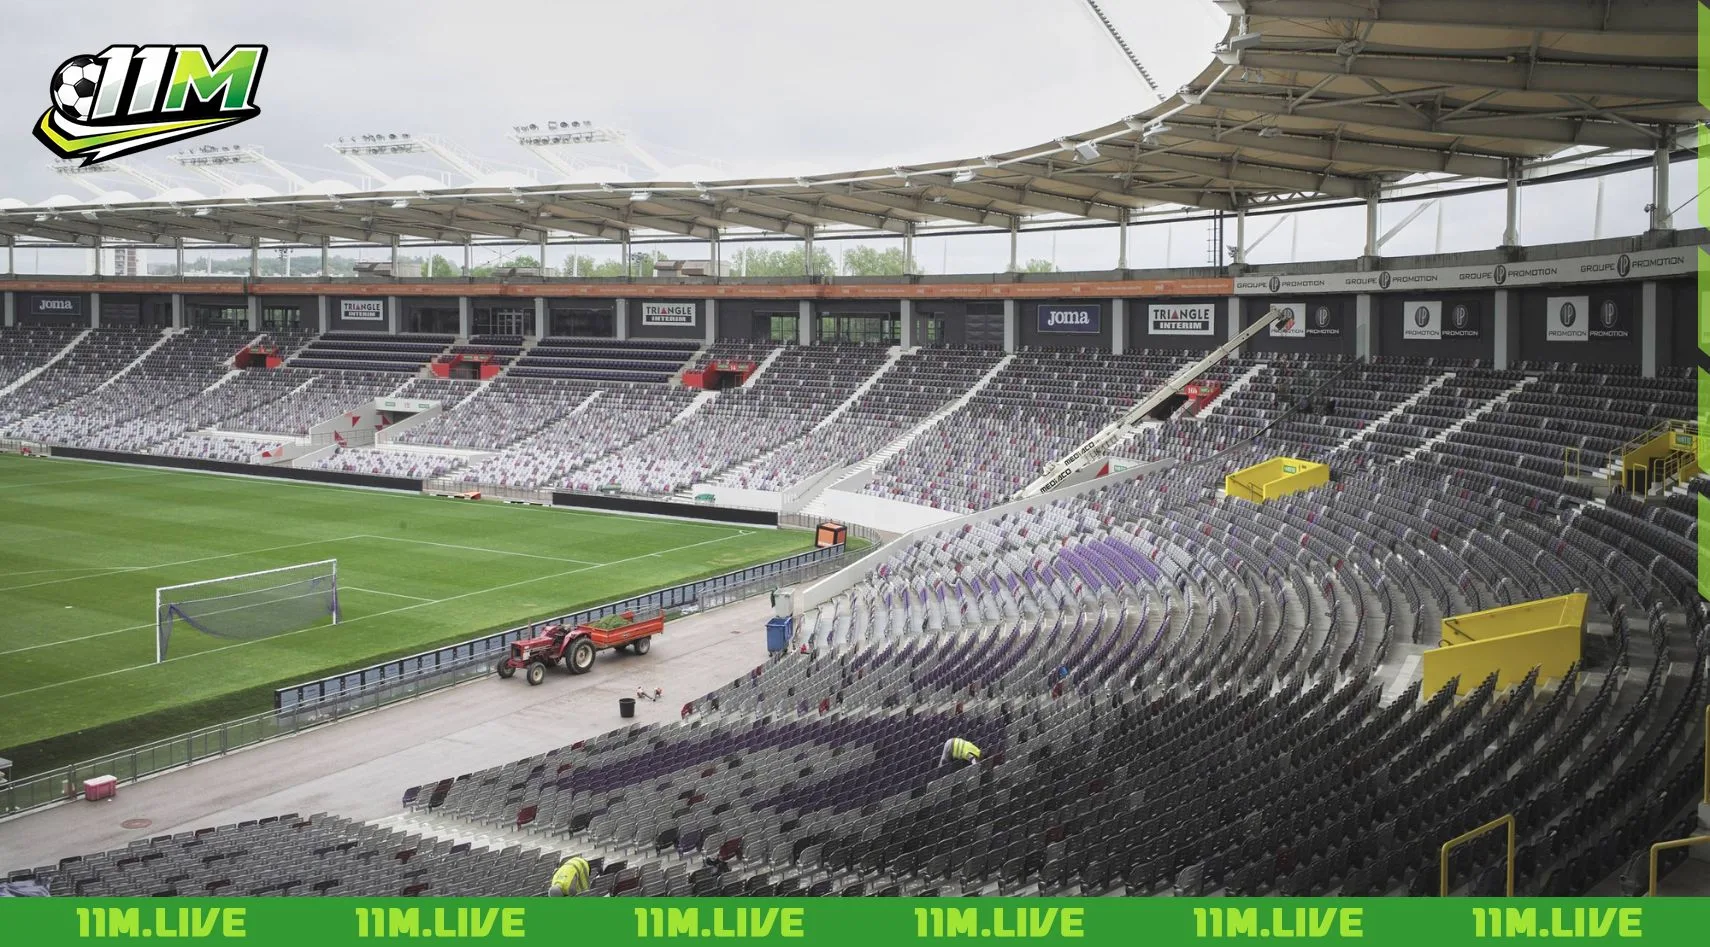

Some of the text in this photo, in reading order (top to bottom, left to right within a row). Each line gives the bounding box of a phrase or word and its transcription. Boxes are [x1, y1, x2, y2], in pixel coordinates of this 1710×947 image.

[1580, 263, 1615, 273] GROUPE
[1632, 256, 1685, 269] PROMOTION
[1459, 272, 1492, 281] GROUPE
[1507, 267, 1557, 278] PROMOTION
[1236, 281, 1267, 289] GROUPE
[1281, 279, 1325, 288] PROMOTION
[1345, 278, 1378, 286] GROUPE
[1392, 275, 1438, 284] PROMOTION
[645, 306, 692, 315] TRIANGLE
[1153, 309, 1210, 320] TRIANGLE
[1159, 321, 1202, 330] INTERIM
